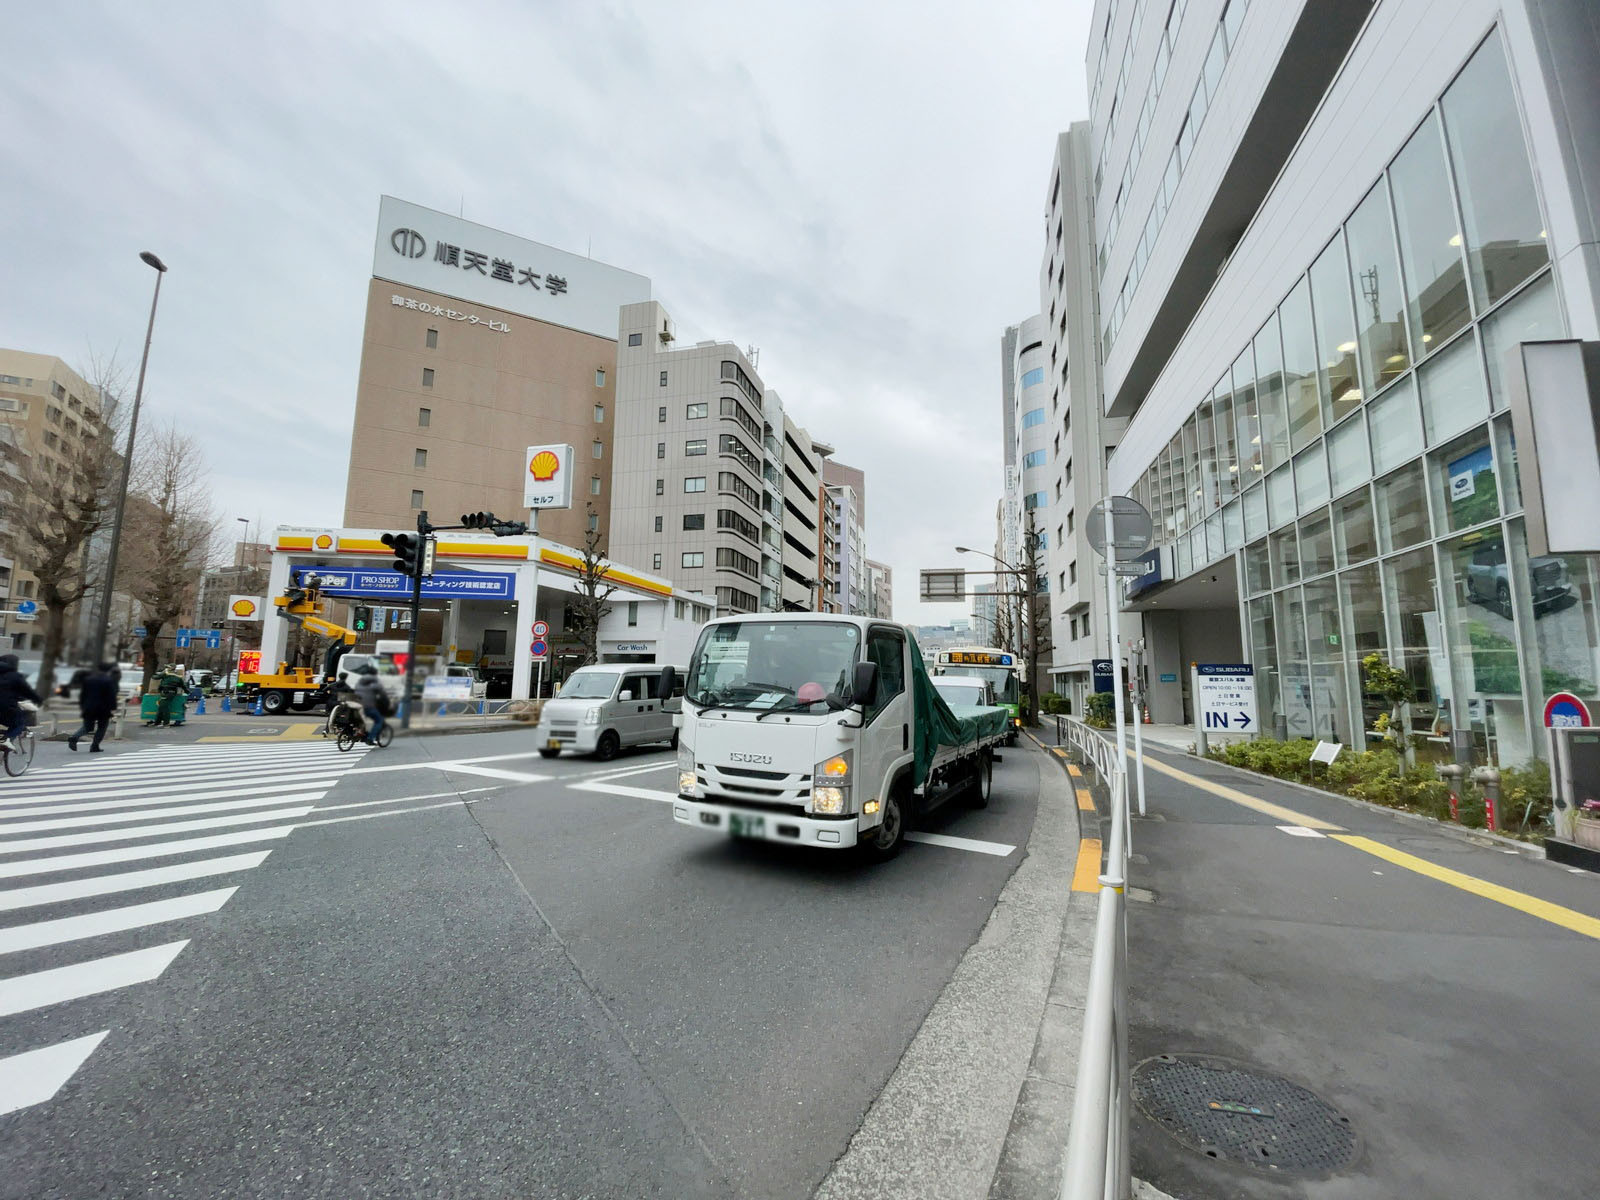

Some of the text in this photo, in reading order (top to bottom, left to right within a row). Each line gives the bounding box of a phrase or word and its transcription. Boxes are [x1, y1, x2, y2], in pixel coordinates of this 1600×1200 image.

[433, 240, 568, 295] 順天堂大学
[391, 294, 511, 334] 御茶の水センタービル
[533, 496, 554, 505] セルフ
[378, 576, 400, 584] SHOP
[420, 580, 501, 590] ーコーティング技術認定店
[535, 625, 545, 634] 40
[1206, 711, 1228, 728] IN
[730, 752, 772, 765] ISUZU
